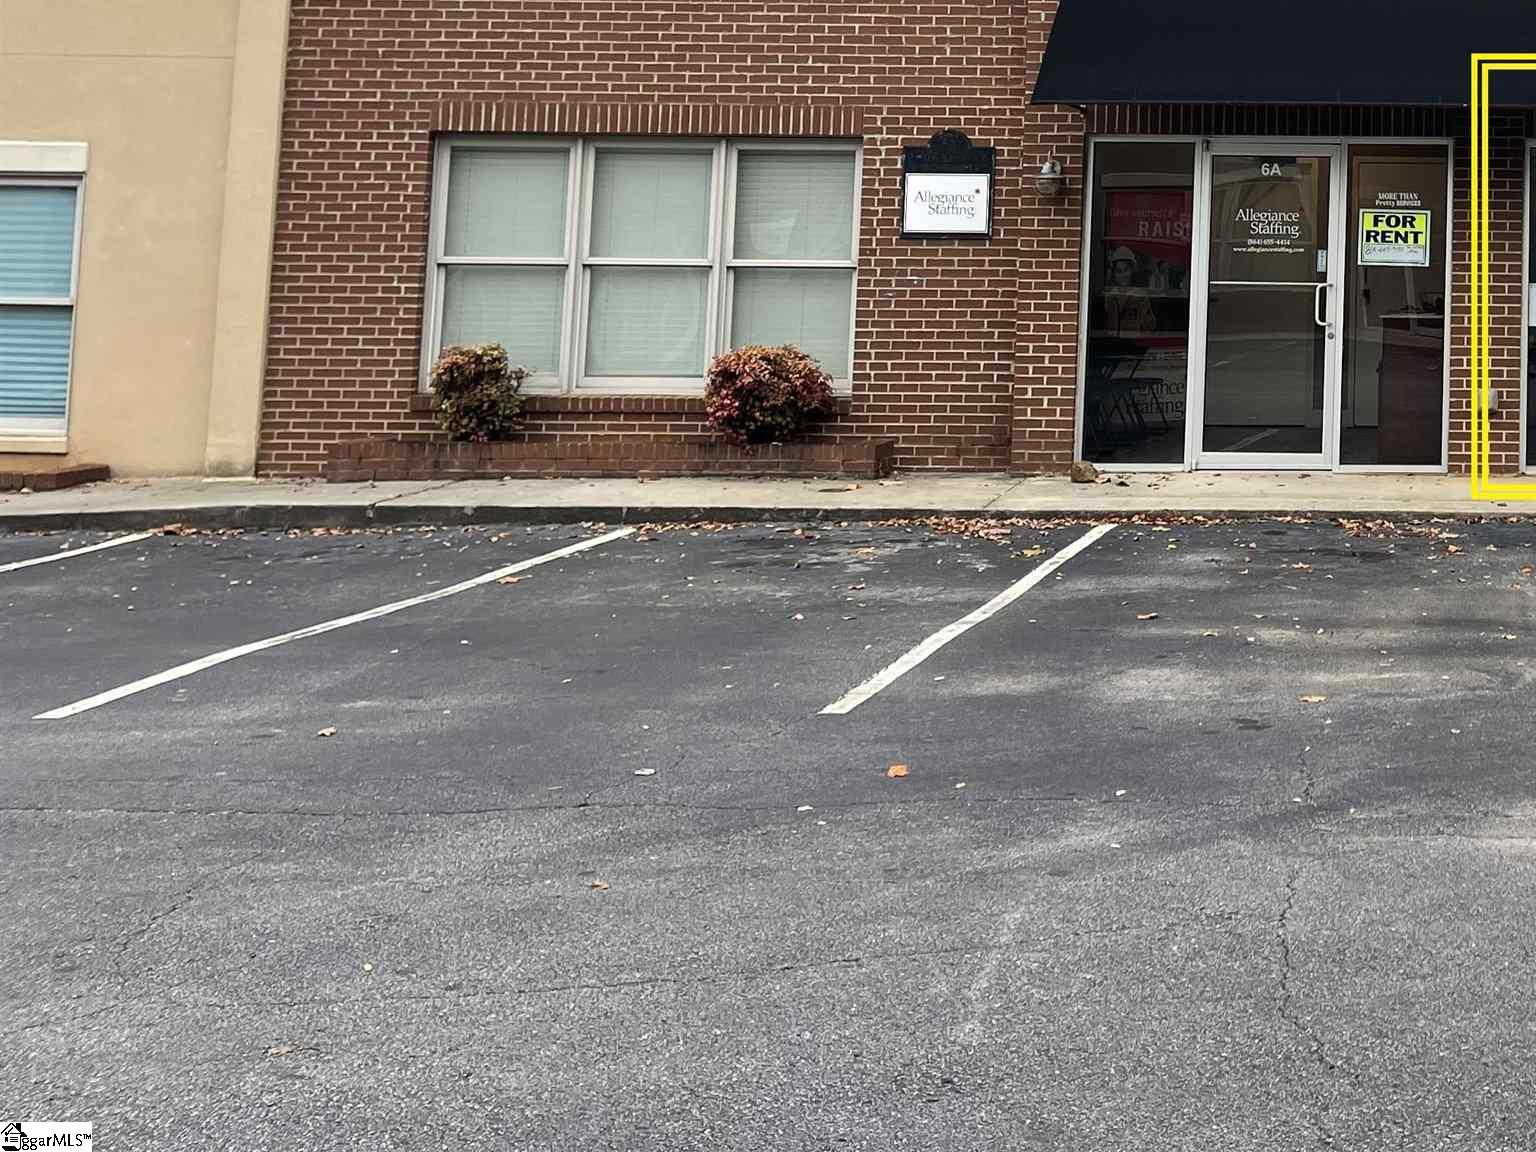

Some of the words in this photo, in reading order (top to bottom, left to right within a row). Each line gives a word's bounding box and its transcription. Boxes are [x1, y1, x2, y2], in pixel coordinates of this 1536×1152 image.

[1261, 162, 1282, 176] 6A
[913, 190, 975, 204] Allegiance
[928, 203, 975, 219] Staffing
[1235, 208, 1300, 225] Allegiance
[1373, 214, 1417, 228] FOR
[1250, 221, 1300, 239] Staffing
[1365, 230, 1424, 244] RENT
